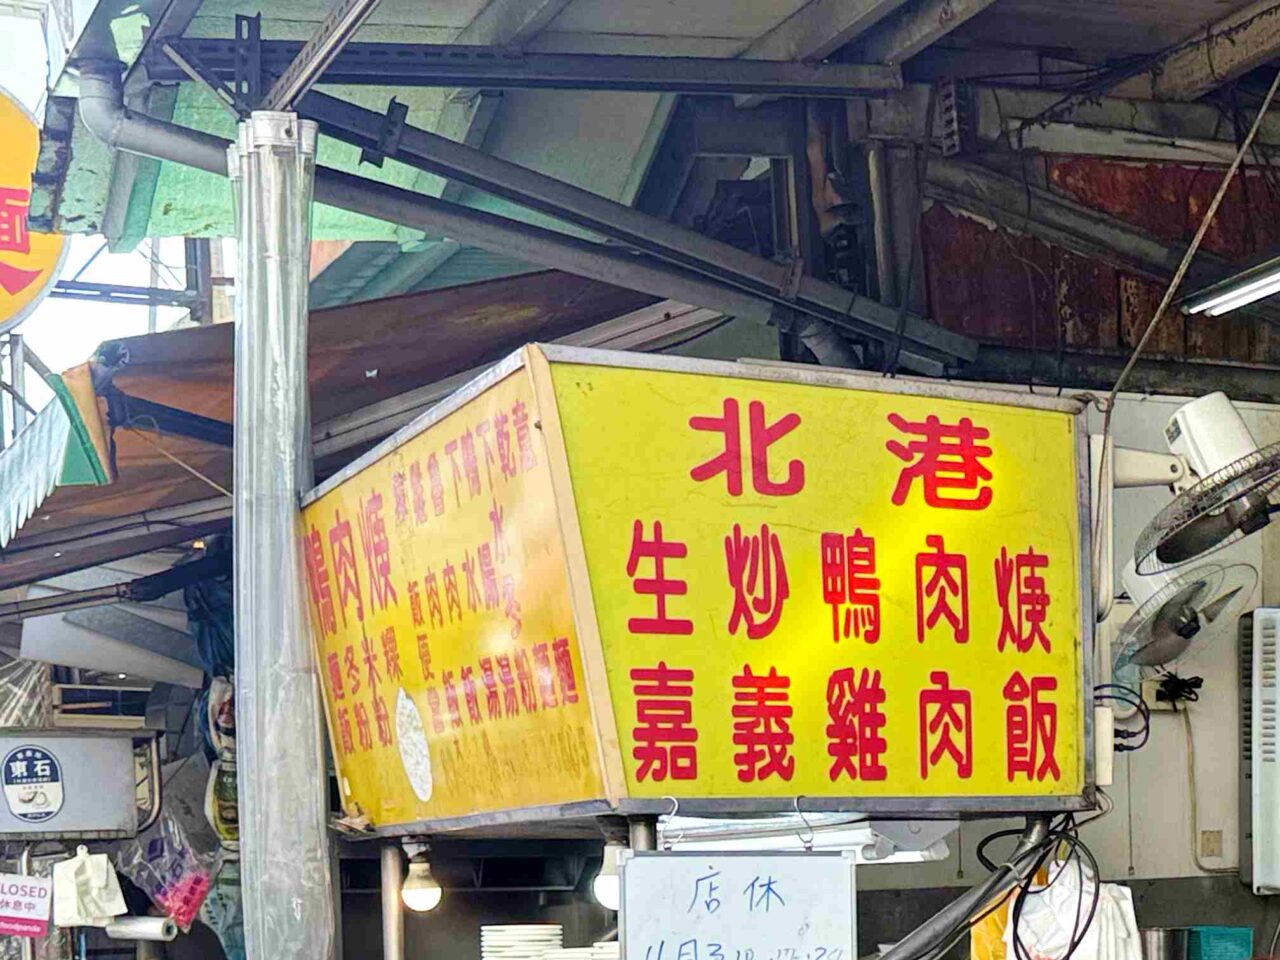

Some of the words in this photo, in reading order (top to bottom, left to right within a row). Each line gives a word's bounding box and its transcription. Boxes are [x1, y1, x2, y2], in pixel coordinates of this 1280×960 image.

[689, 397, 993, 510] 北港
[626, 518, 1052, 654] 生炒鴨肉焿
[630, 661, 1060, 782] 嘉義雞肉飯
[9, 759, 51, 778] 東石
[0, 883, 48, 899] LOSED
[687, 865, 785, 914] 店休
